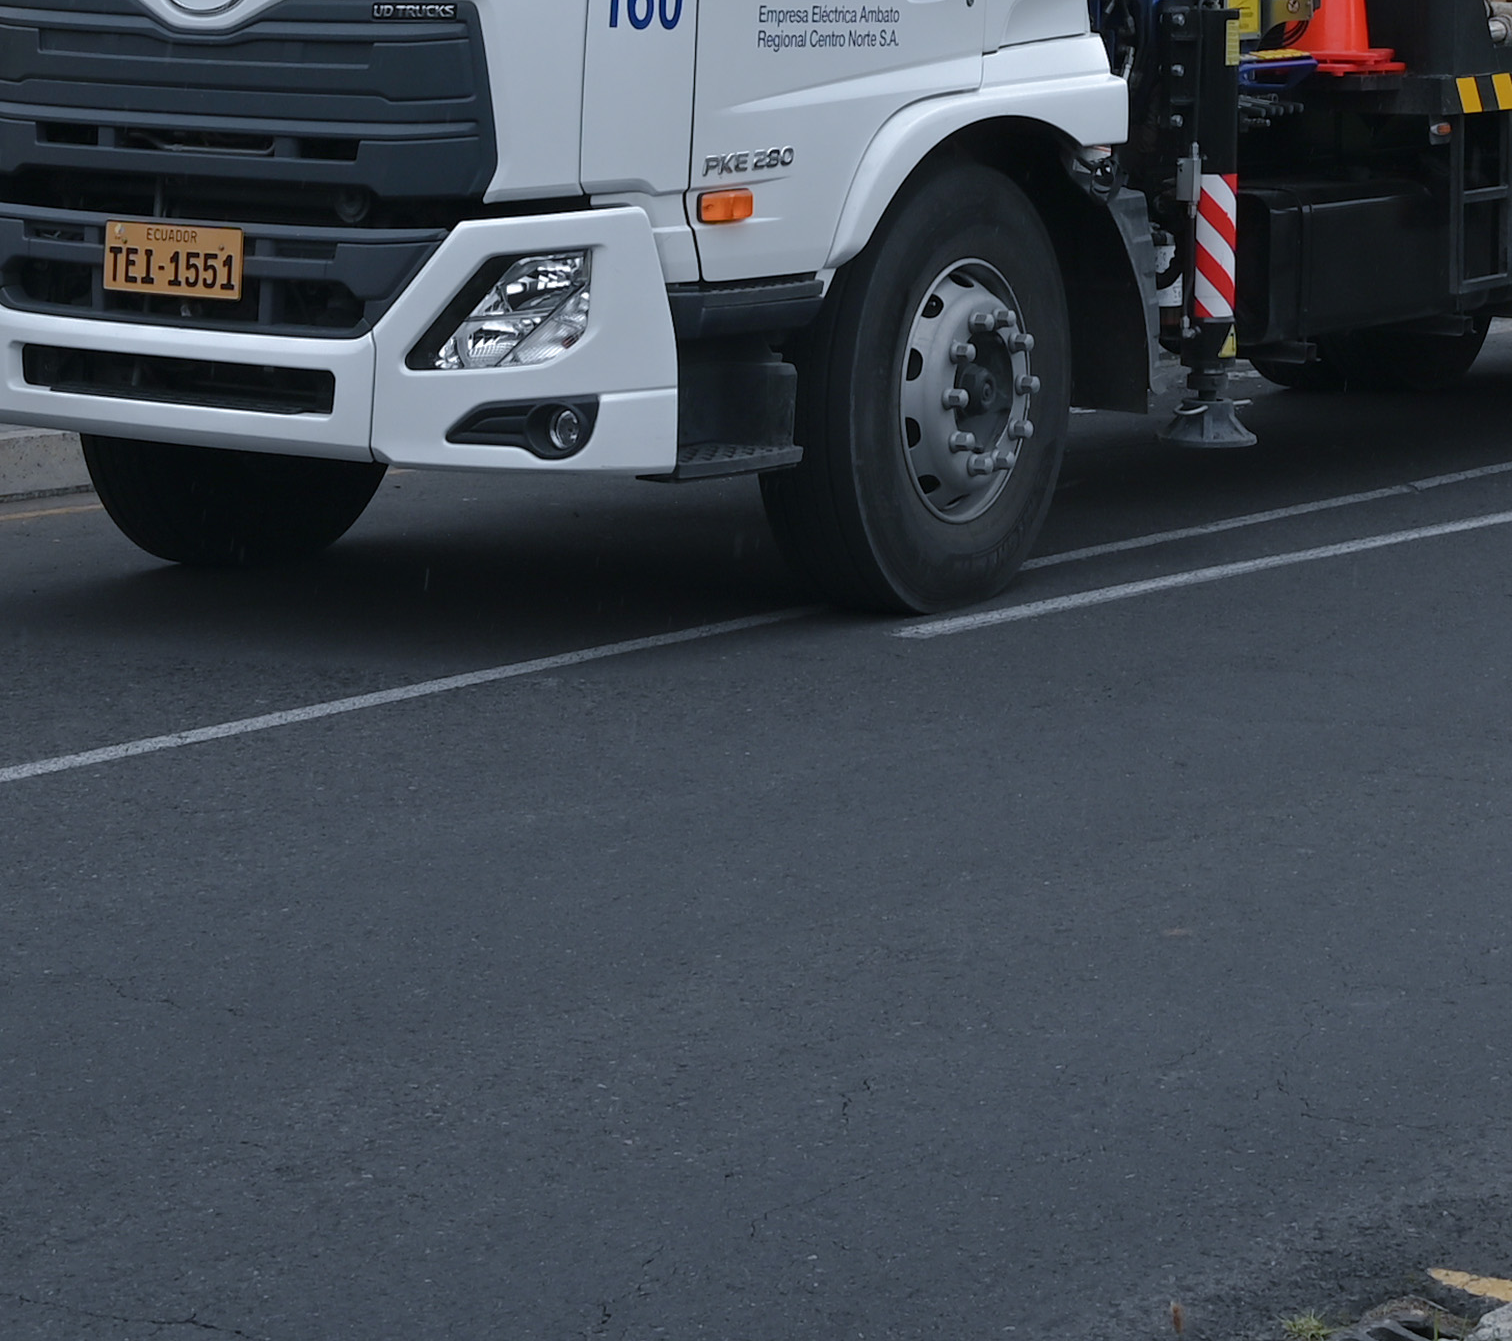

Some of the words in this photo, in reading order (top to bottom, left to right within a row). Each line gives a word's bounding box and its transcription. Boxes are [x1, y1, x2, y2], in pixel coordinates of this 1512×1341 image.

[373, 4, 394, 17] UD
[396, 4, 455, 17] TRUCKS
[758, 5, 808, 27] Empresa
[812, 4, 857, 23] Eléctrica
[859, 5, 900, 23] Ambato
[757, 30, 807, 53] Regional
[809, 29, 846, 48] Centro
[848, 29, 877, 47] Norte
[879, 29, 899, 47] S.A.
[701, 150, 750, 177] PKE
[751, 145, 795, 172] 280
[146, 227, 198, 243] ECUADOR
[109, 246, 235, 291] TEI-1551
